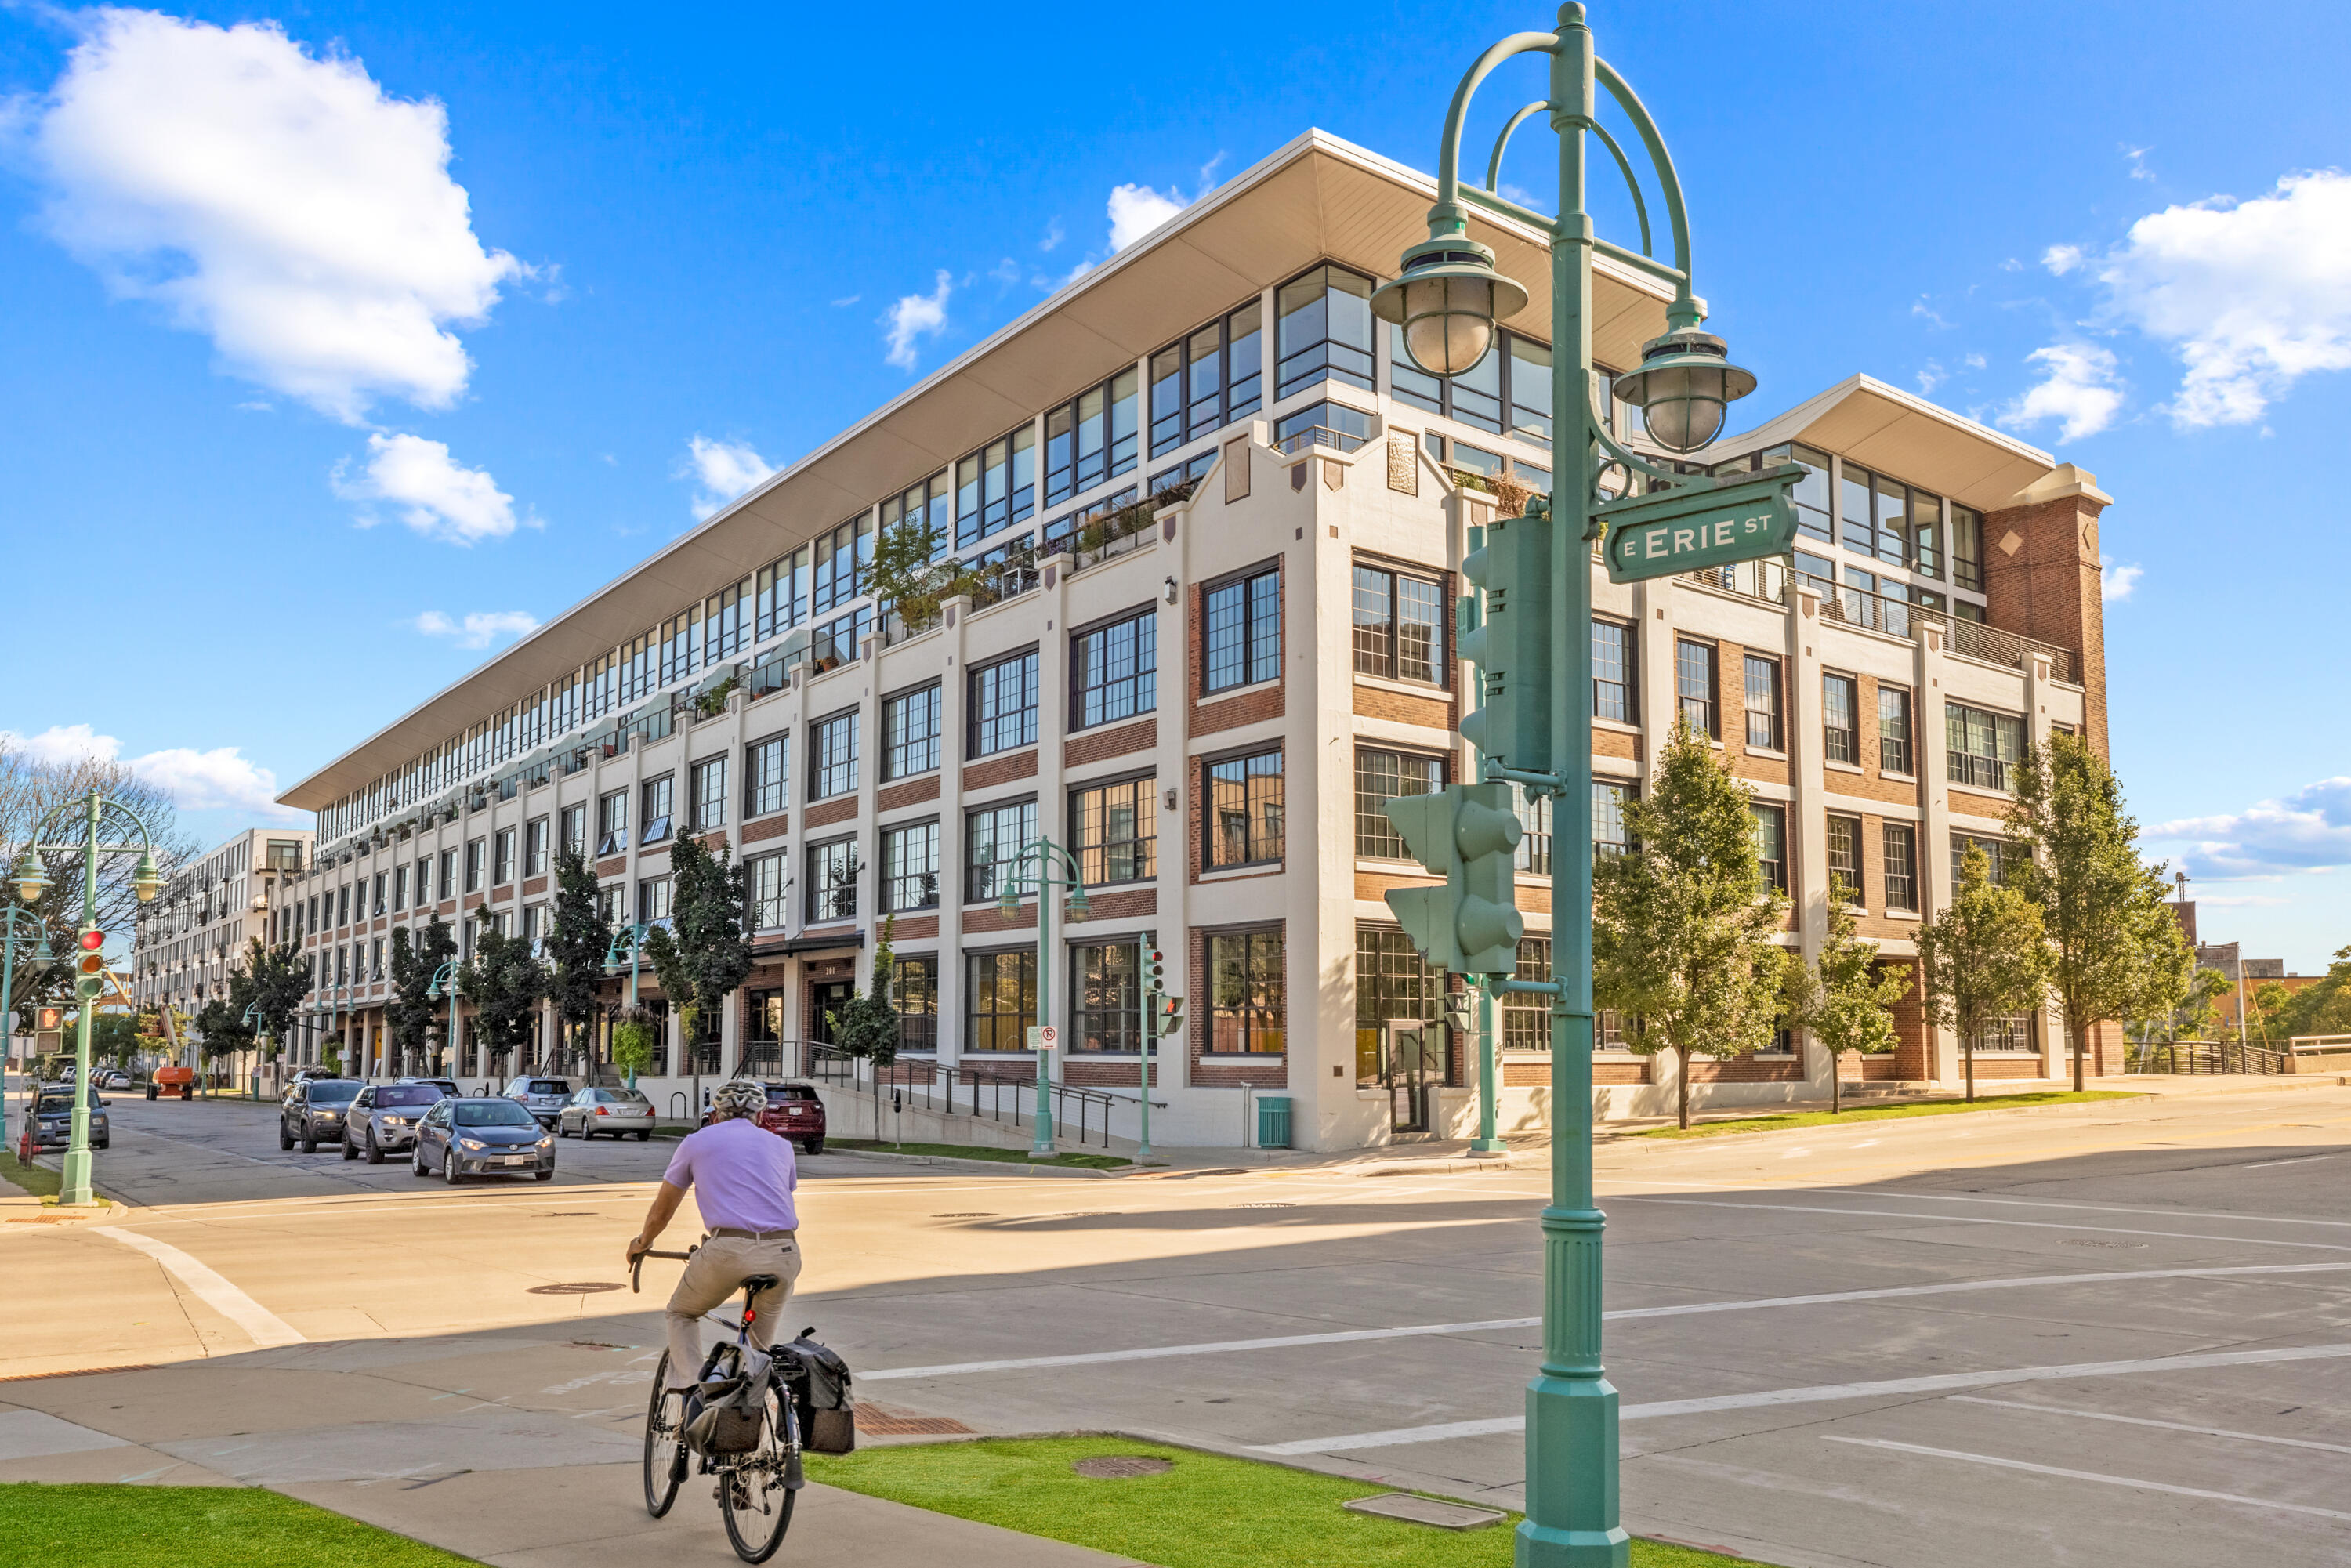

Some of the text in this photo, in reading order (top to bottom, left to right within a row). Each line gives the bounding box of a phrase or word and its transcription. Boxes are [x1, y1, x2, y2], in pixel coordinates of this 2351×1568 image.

[1624, 514, 1773, 559] E ERIE ST
